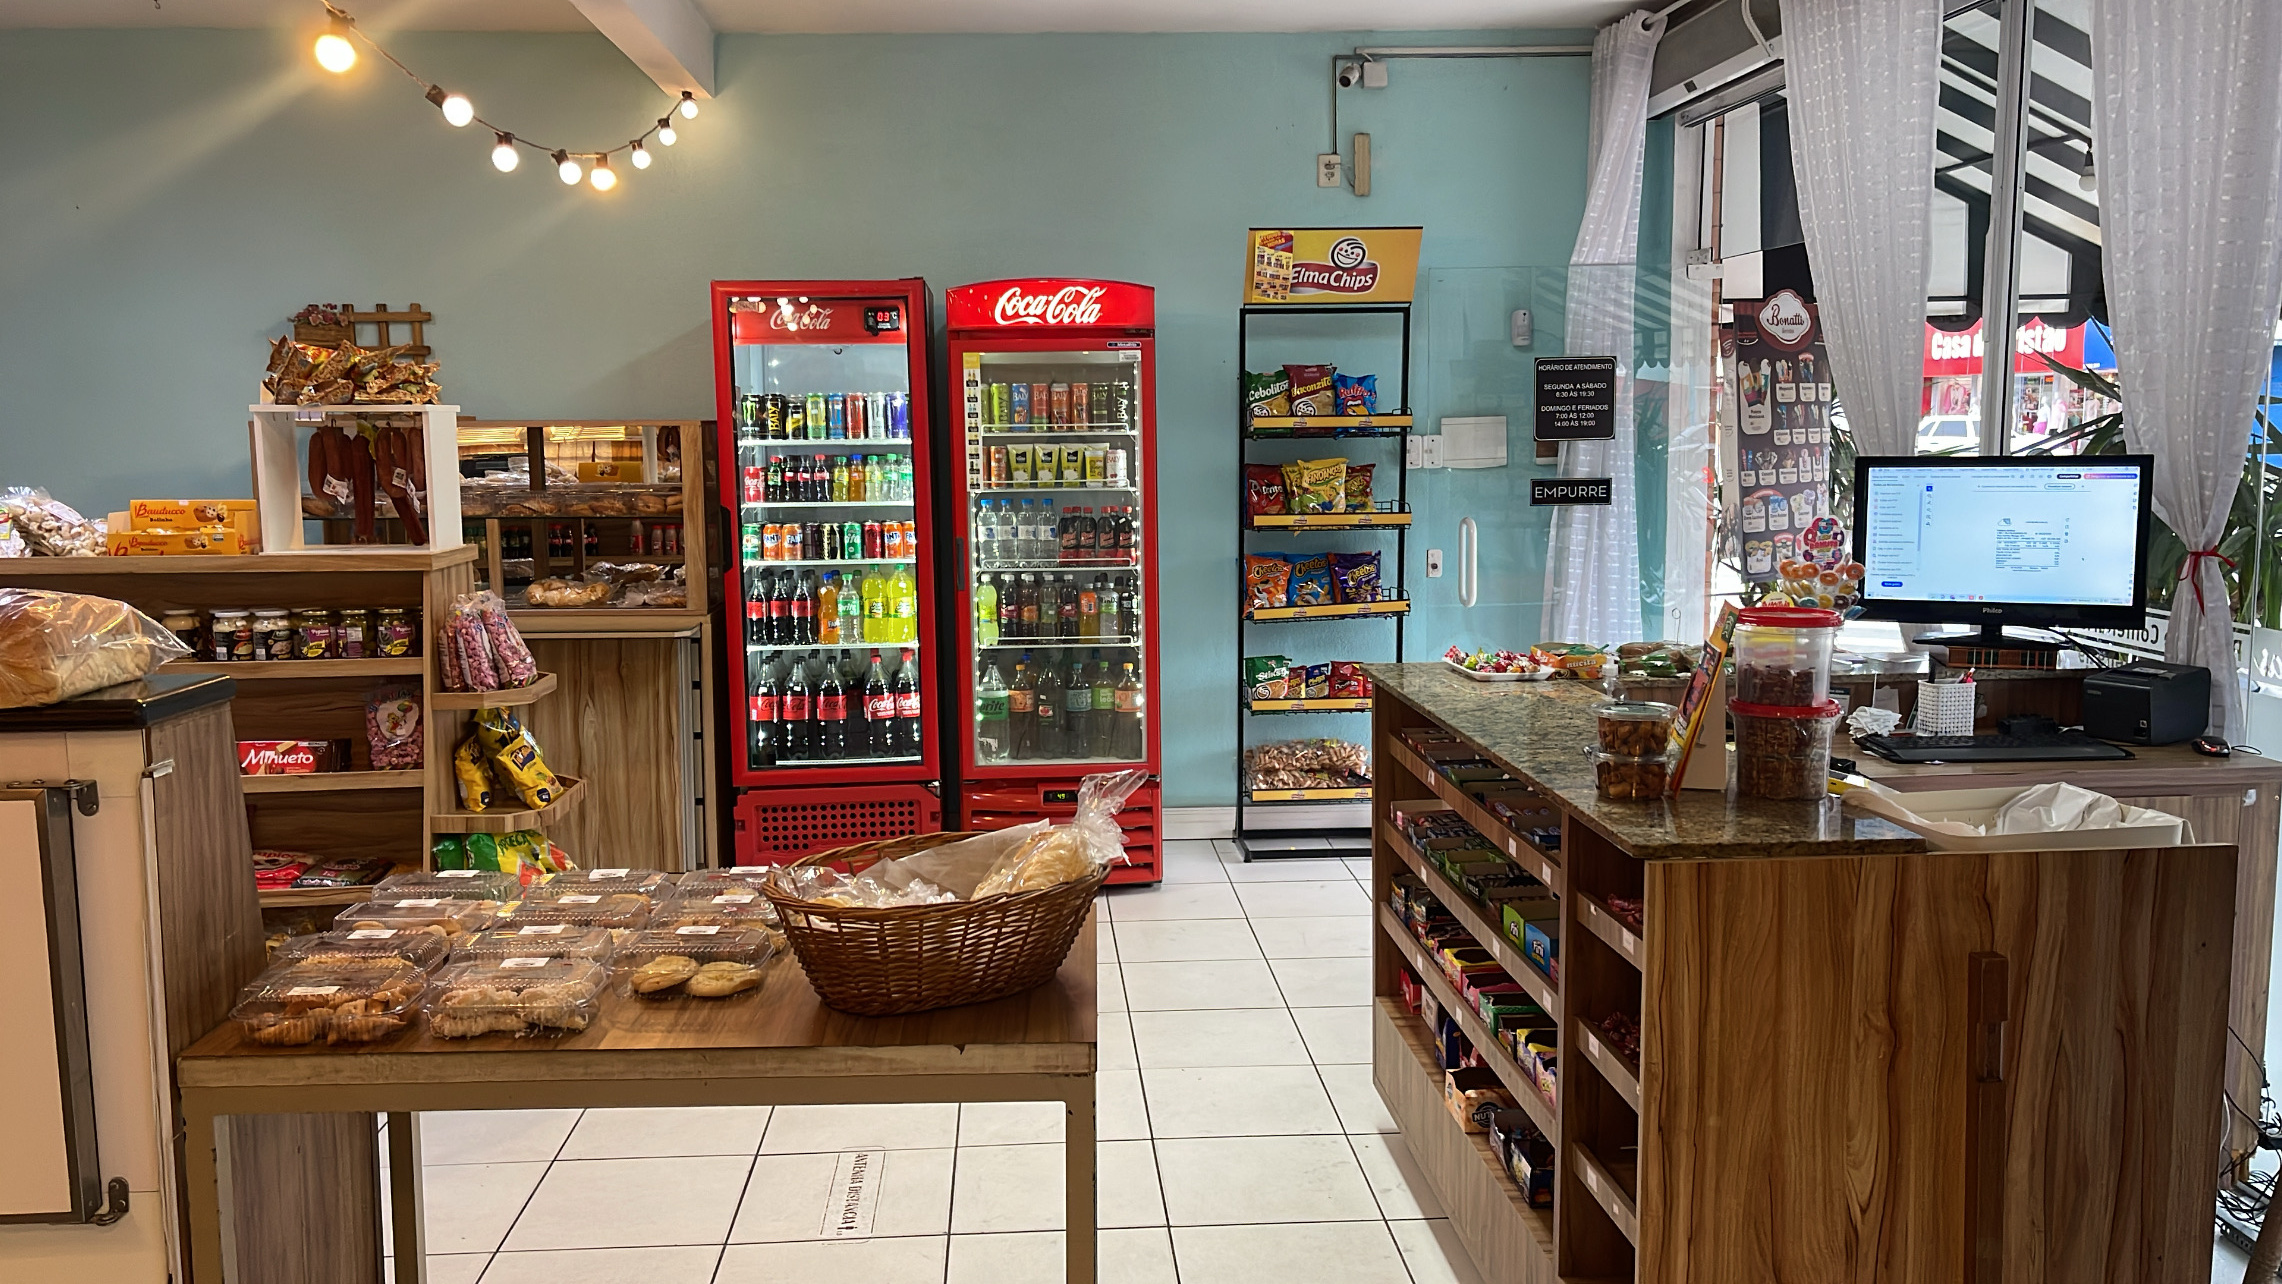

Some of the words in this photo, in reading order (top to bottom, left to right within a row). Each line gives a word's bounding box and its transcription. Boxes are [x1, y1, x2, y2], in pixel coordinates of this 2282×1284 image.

[994, 286, 1108, 325] Coca-Cola
[876, 311, 890, 322] 03
[1766, 303, 1805, 327] Bonatti
[1931, 332, 1971, 360] Casa
[1538, 363, 1564, 371] HORÁRIO
[1573, 363, 1613, 371] ATENDIMENTO
[1291, 375, 1333, 398] Baconzito
[1581, 381, 1607, 389] SÁBADO
[1013, 391, 1028, 401] BALY
[1541, 404, 1571, 412] DOMINGO
[768, 401, 782, 432] BALY
[1535, 486, 1608, 498] EMPURRE
[134, 502, 186, 518] Bauducco
[1252, 562, 1284, 579] Cheetos
[1294, 556, 1328, 578] Cheetos
[1347, 564, 1376, 587] Cheetos
[1566, 660, 1597, 669] nucita
